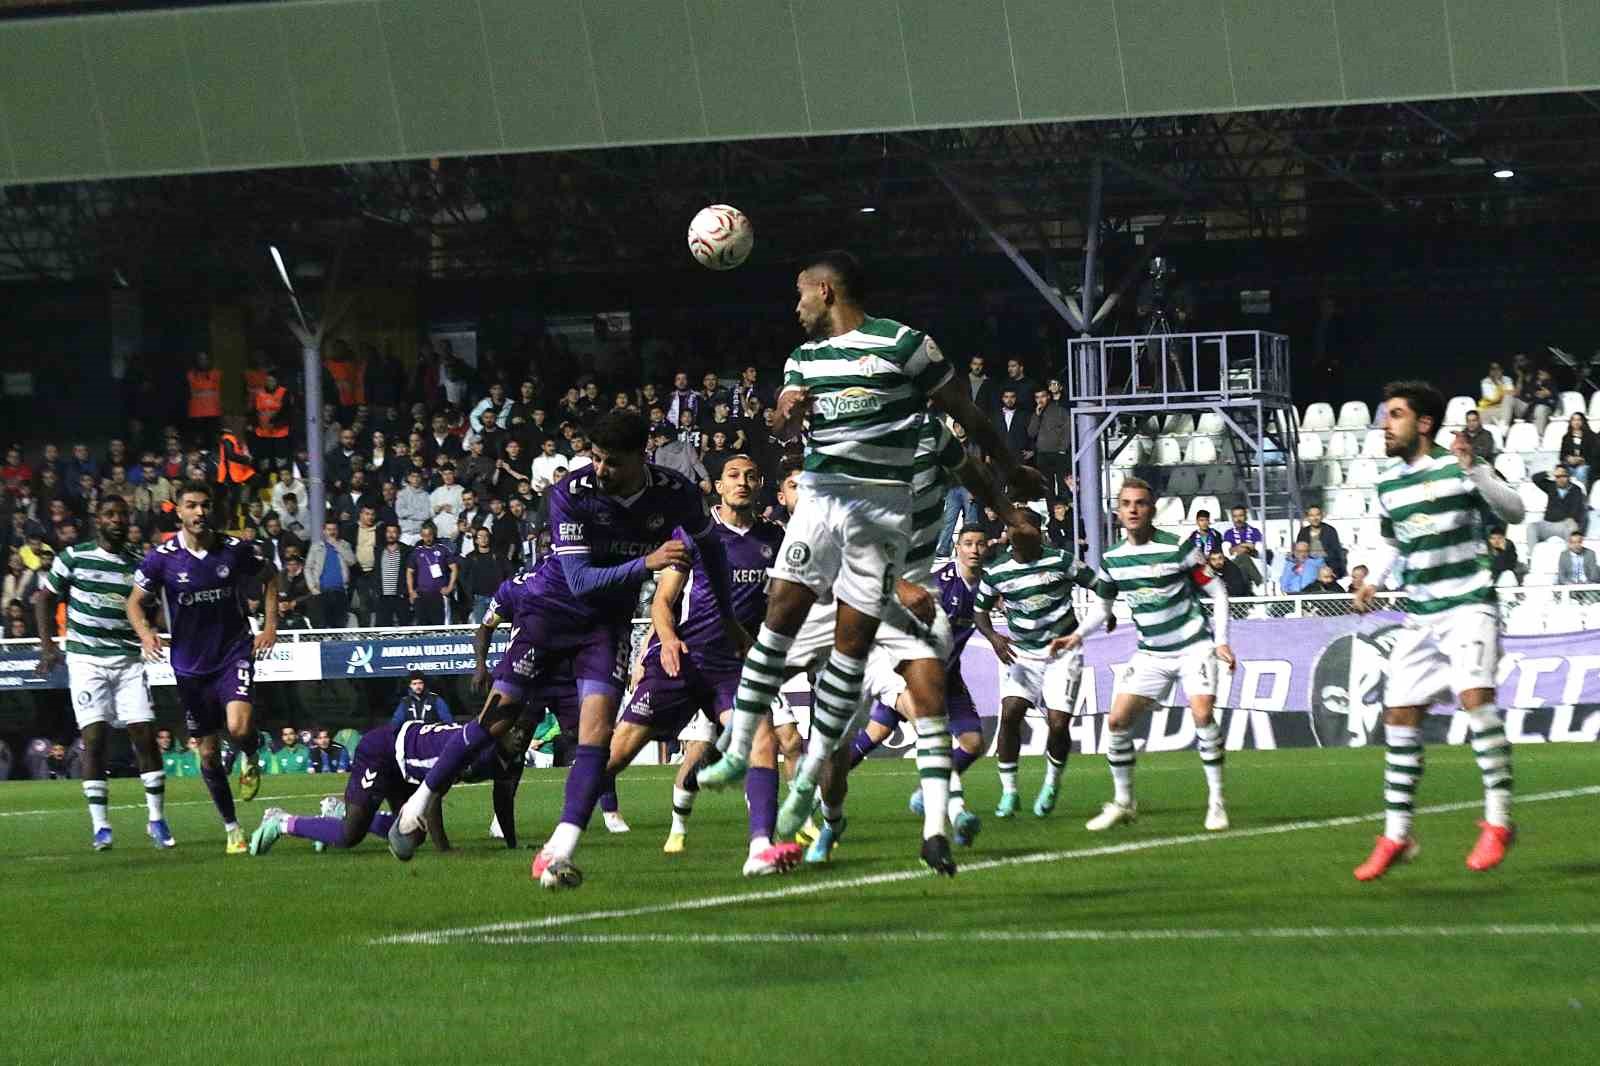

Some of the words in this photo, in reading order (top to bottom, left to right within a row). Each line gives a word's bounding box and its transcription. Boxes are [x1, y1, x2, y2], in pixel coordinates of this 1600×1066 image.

[828, 395, 879, 416] Yörsan
[559, 523, 584, 534] ERY
[237, 668, 250, 685] 4
